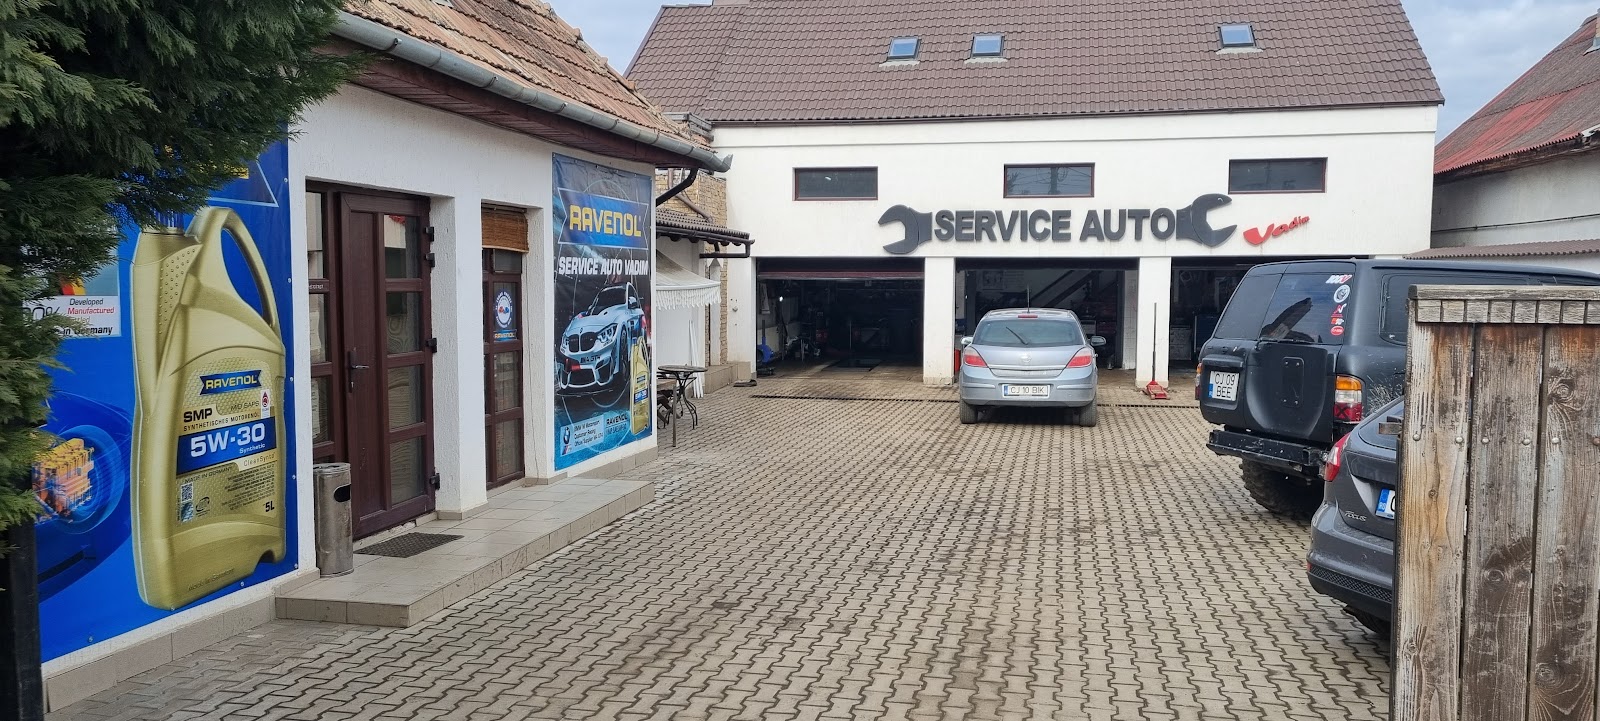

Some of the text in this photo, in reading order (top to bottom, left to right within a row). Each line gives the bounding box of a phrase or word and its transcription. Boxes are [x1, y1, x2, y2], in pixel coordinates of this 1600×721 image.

[569, 204, 642, 237] RAVENOL
[934, 207, 1176, 242] SERVICE AUTO
[1243, 216, 1310, 246] Vadim
[558, 256, 649, 276] SERVICE AUTO VADIM
[69, 298, 104, 307] Developed
[67, 307, 115, 315] Manufactured
[205, 374, 258, 390] RAVENOL
[1215, 373, 1235, 386] CJ 09
[1010, 386, 1020, 394] CJ
[1031, 386, 1045, 394] BIK
[1216, 385, 1232, 398] BEE
[243, 401, 260, 409] SAPS
[183, 407, 213, 423] SMP
[607, 414, 628, 425] RAVENOL
[183, 417, 229, 431] SYNTHETISCHES
[191, 423, 265, 457] 5W-30
[239, 443, 266, 454] Synthetic
[265, 501, 275, 513] 5L
[1345, 510, 1367, 522] FOCUS
